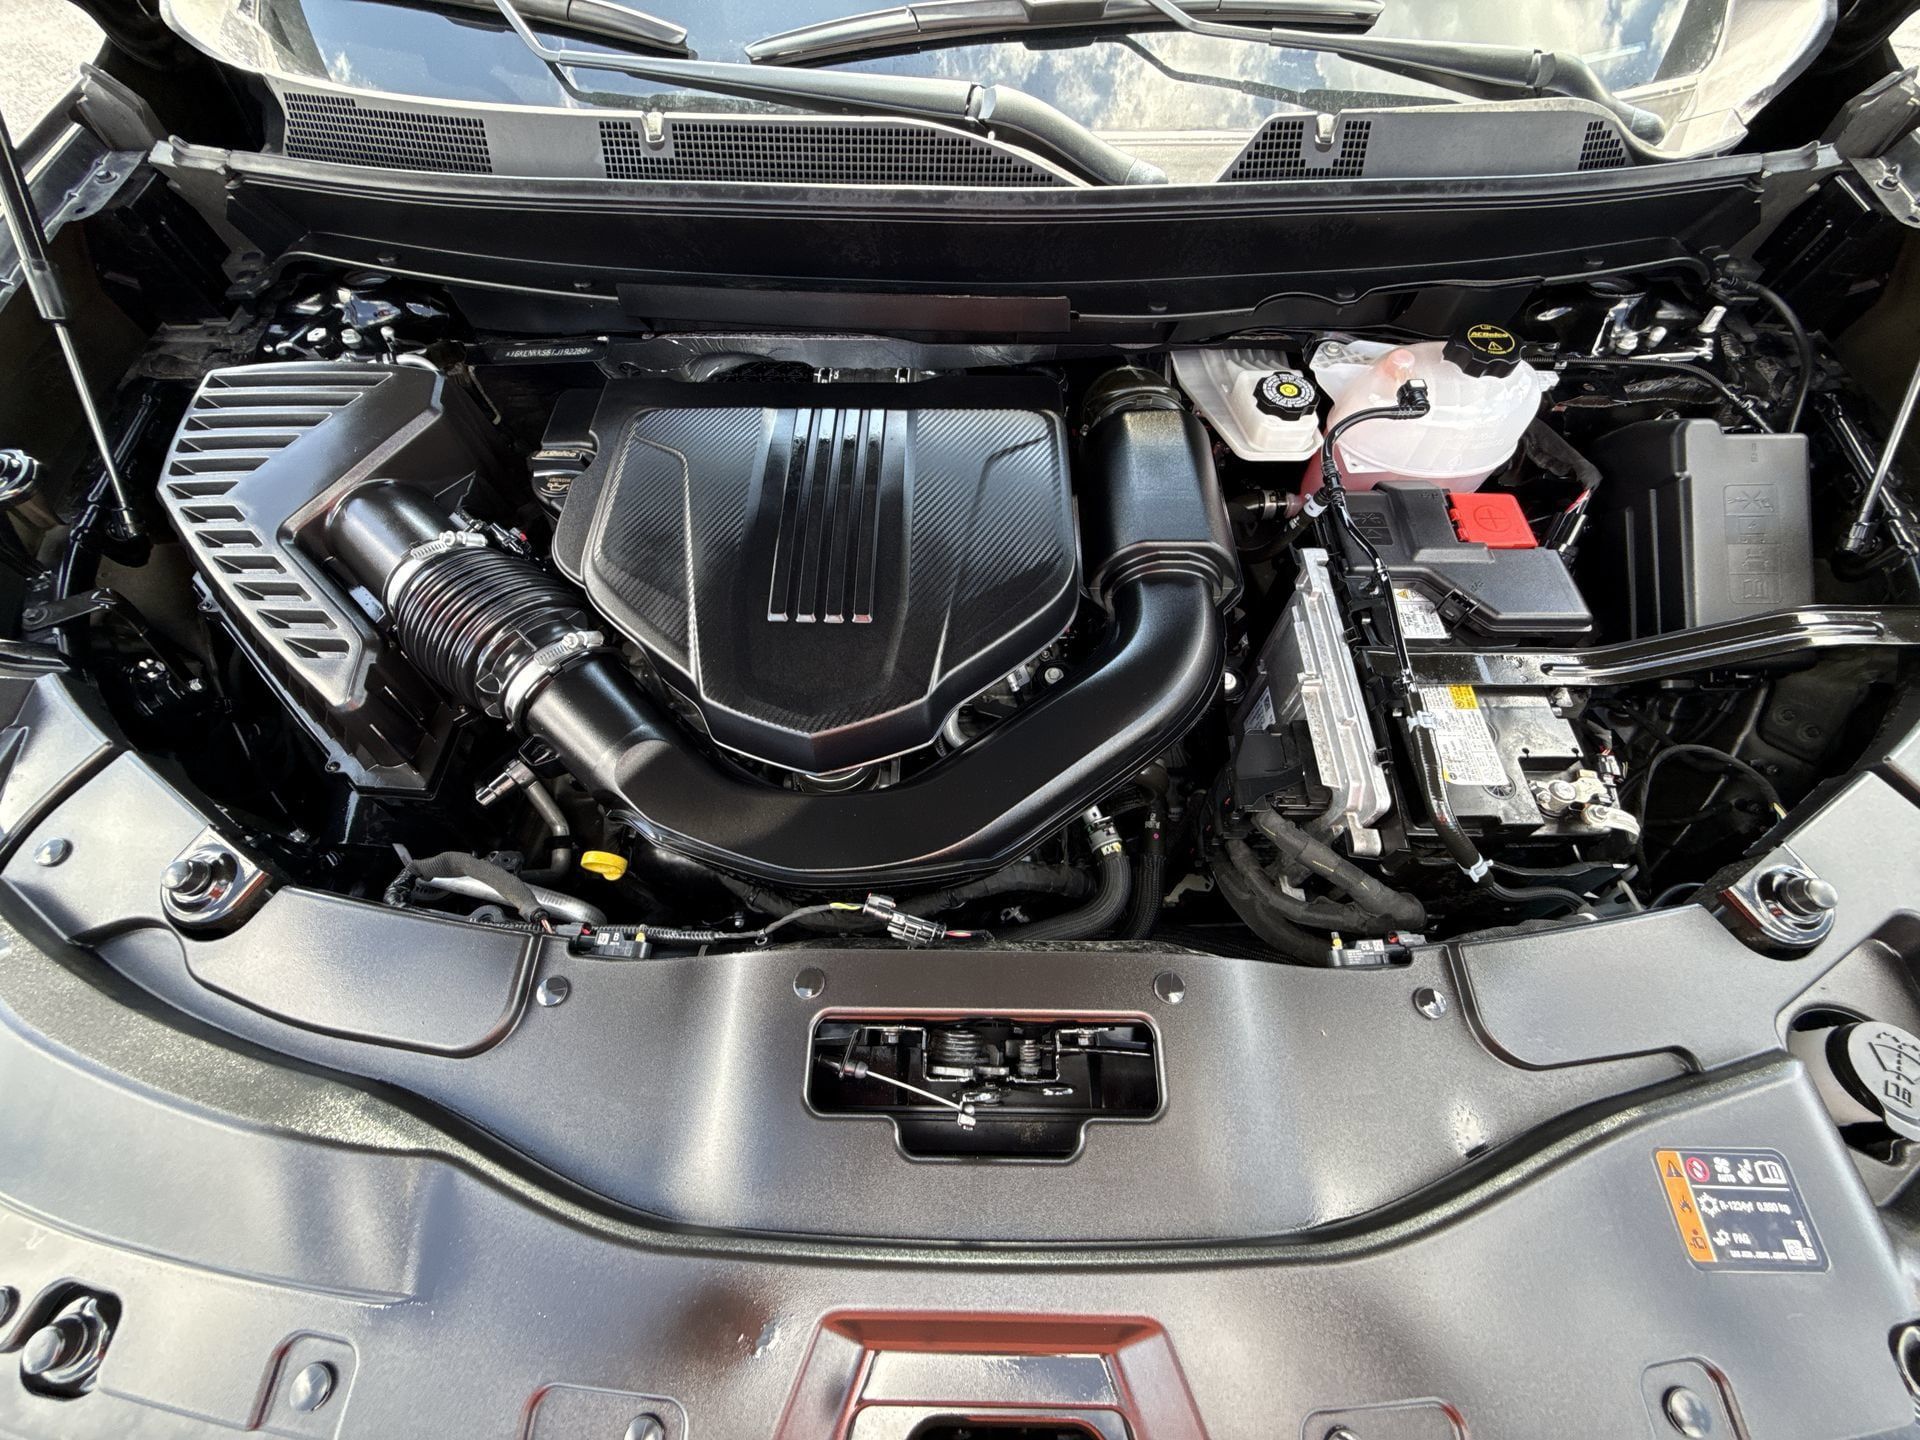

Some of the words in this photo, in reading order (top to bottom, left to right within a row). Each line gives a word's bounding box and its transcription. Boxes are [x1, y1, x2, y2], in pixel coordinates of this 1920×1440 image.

[1717, 1173, 1737, 1183] AUTO
[1779, 1202, 1792, 1215] kg
[1732, 1232, 1751, 1245] PAG
